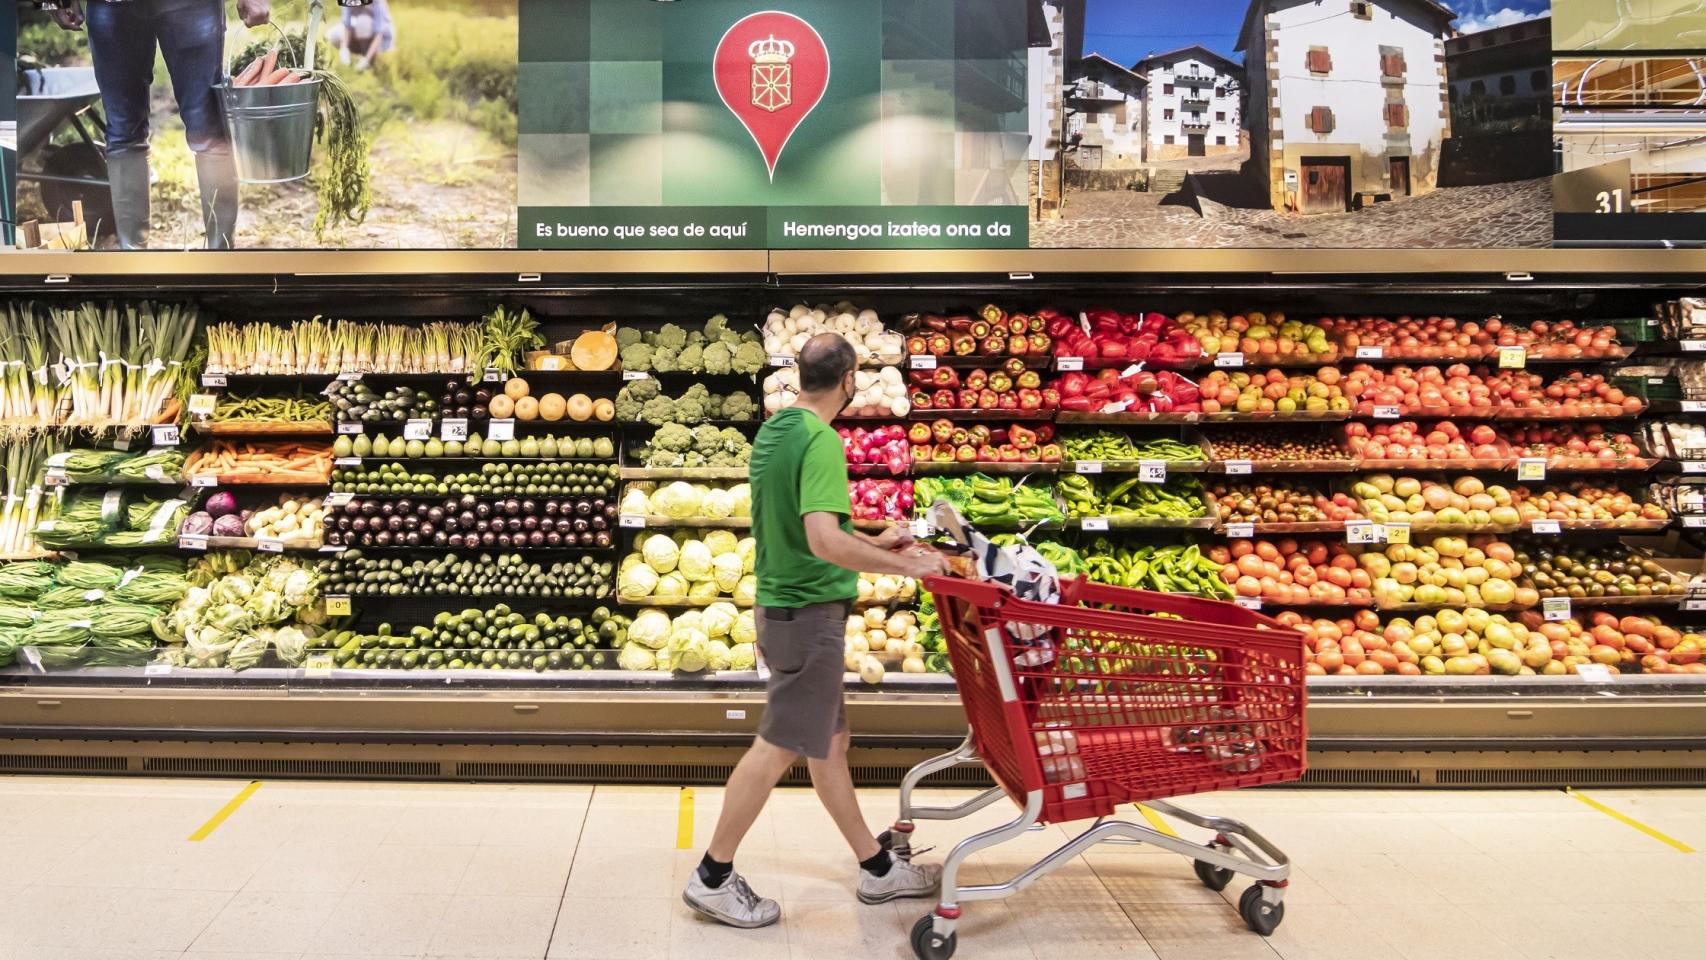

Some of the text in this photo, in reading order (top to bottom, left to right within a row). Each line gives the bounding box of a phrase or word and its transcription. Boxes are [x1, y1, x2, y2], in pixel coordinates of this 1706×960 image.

[1595, 188, 1623, 214] 31
[536, 221, 748, 240] Es bueno que sea de aquí
[783, 220, 1011, 241] Hemengoa izatea ona da
